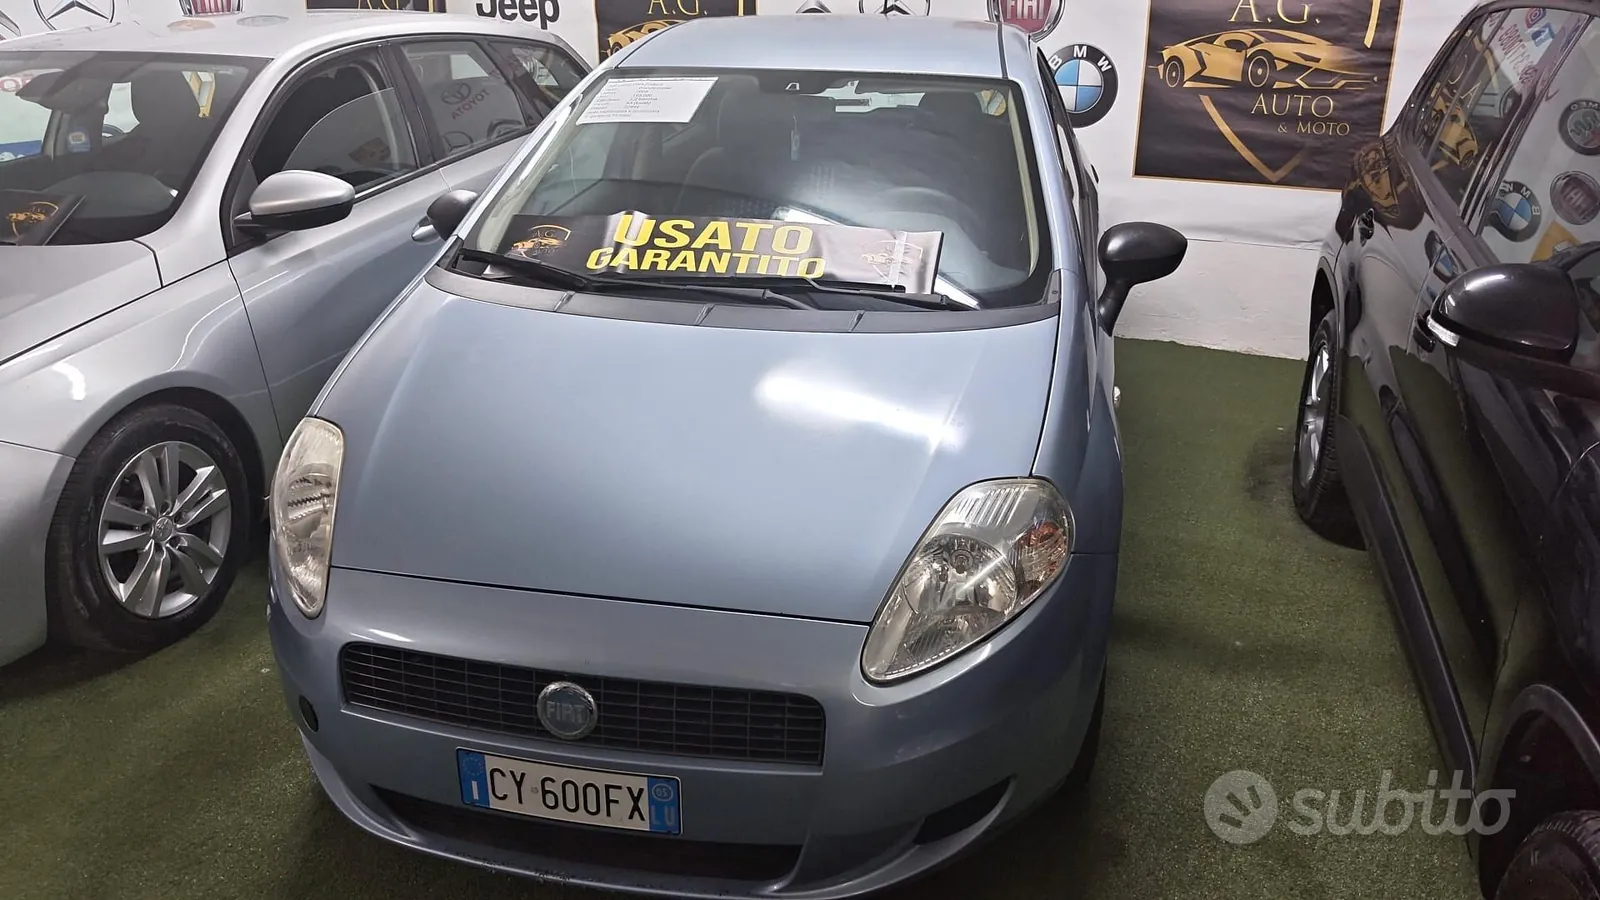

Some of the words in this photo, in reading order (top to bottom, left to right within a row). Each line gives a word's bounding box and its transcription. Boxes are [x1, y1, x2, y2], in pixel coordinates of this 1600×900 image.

[475, 0, 560, 30] Jeep
[1250, 92, 1334, 118] AUTO
[1277, 122, 1289, 134] &
[1296, 121, 1350, 136] MOTO
[613, 213, 814, 255] USATO
[586, 247, 826, 279] GARANTITO
[546, 700, 586, 724] FIAT
[489, 767, 526, 804] CY
[540, 776, 646, 821] 600FX
